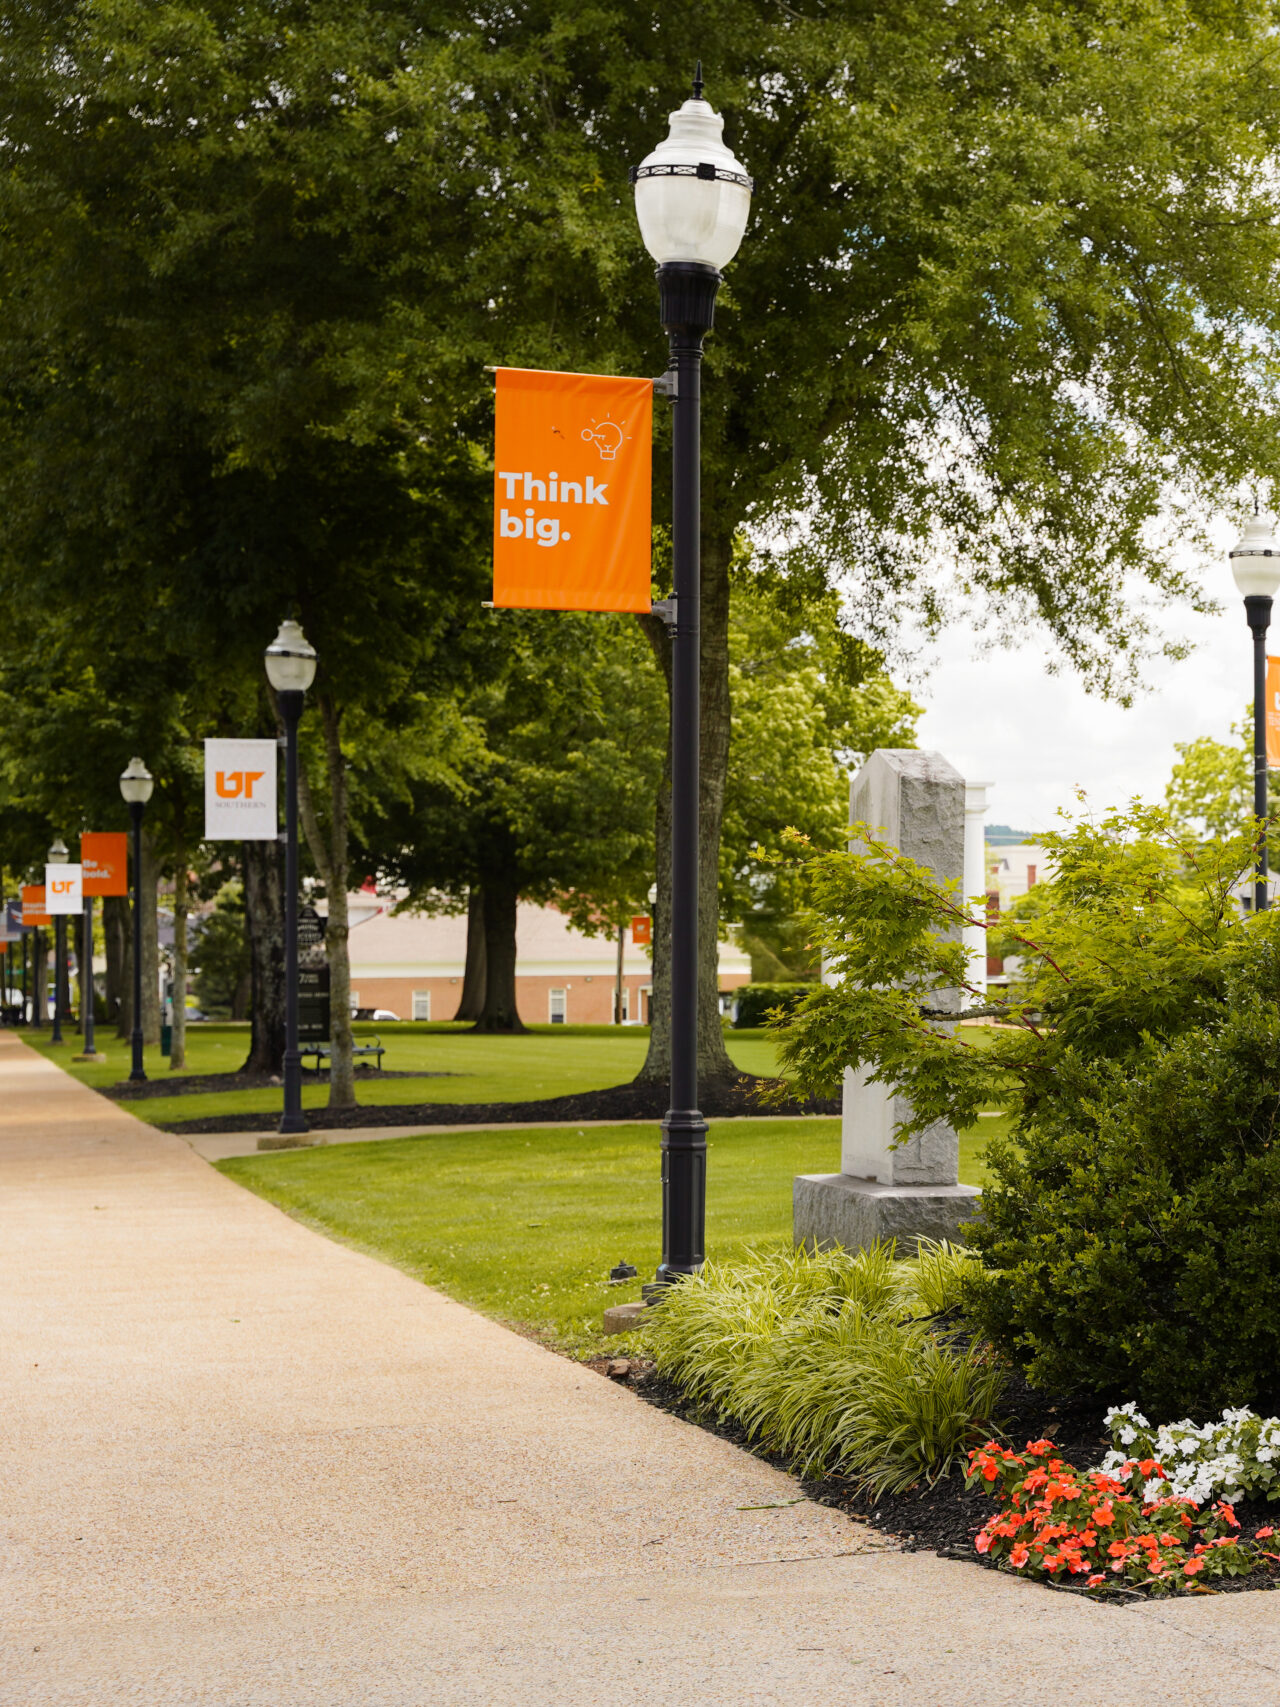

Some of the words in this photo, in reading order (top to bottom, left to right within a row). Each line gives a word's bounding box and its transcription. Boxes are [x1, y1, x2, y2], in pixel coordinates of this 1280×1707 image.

[499, 471, 609, 505] Think
[500, 508, 571, 547] big.
[215, 771, 266, 799] UT
[215, 801, 267, 809] SOUTHERN
[82, 860, 98, 869] Be
[51, 880, 75, 894] UT
